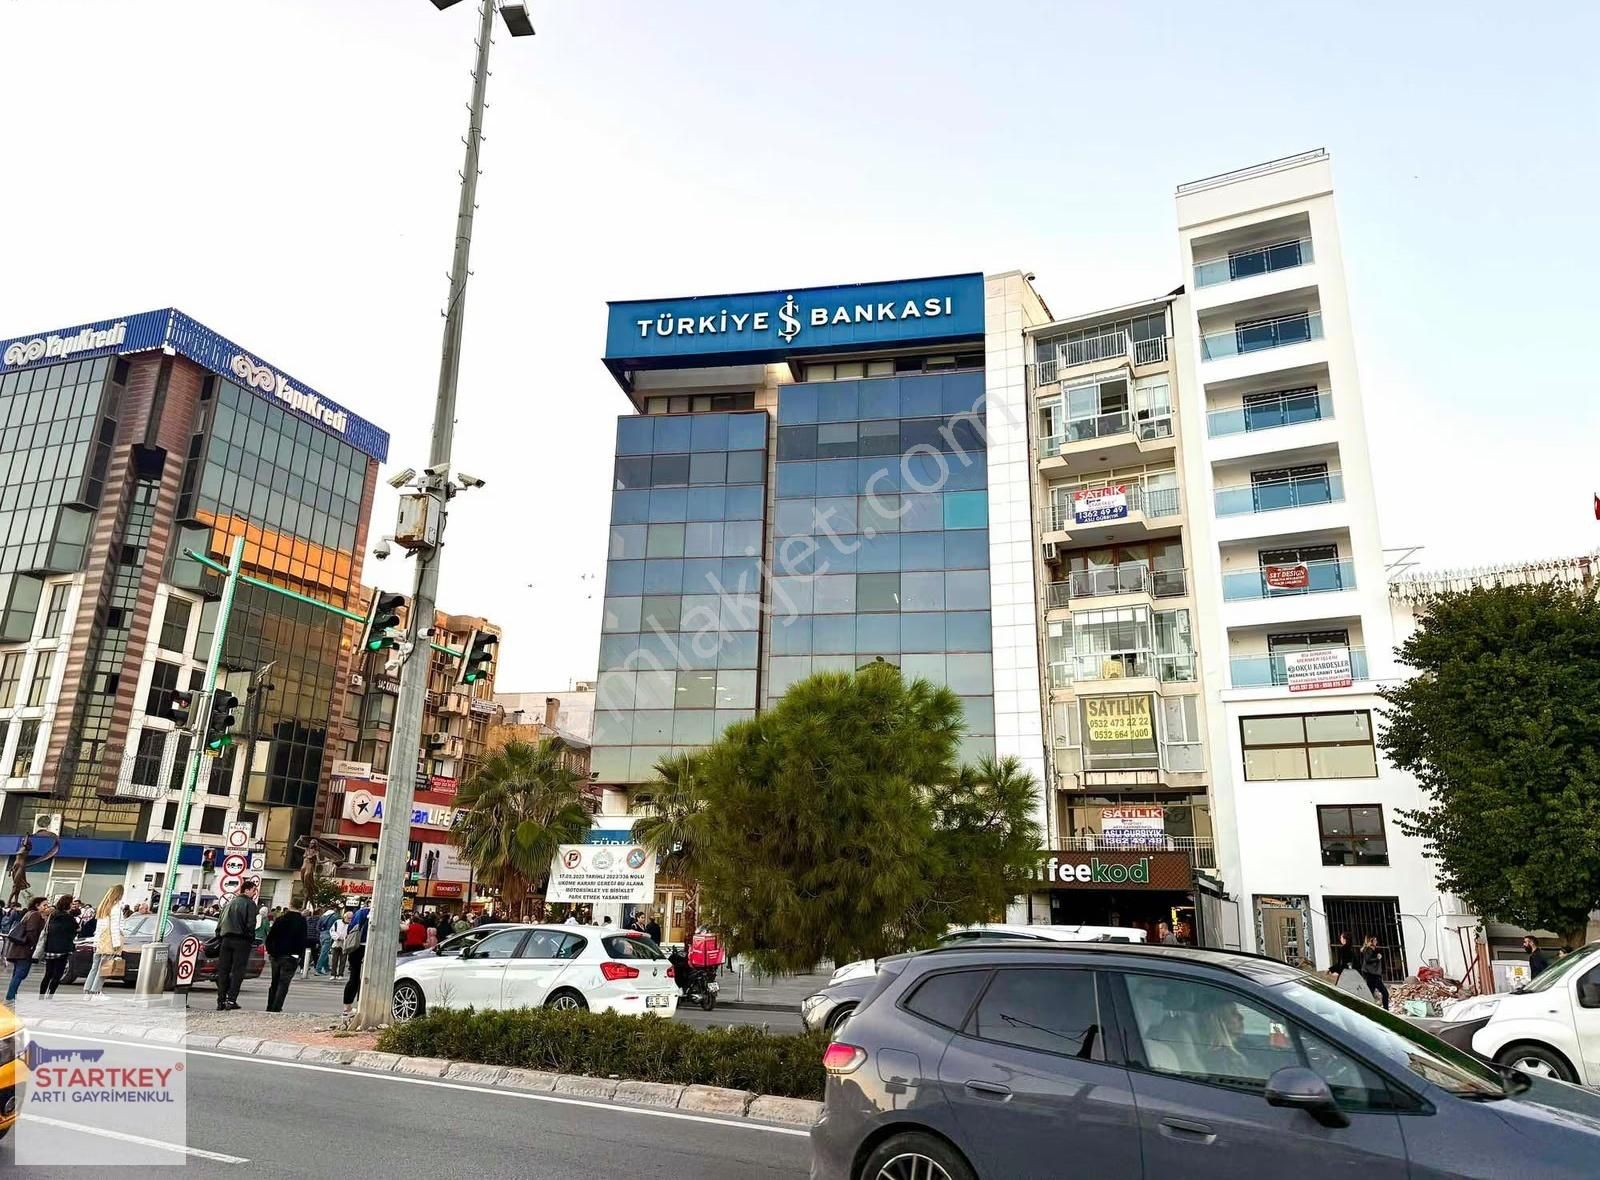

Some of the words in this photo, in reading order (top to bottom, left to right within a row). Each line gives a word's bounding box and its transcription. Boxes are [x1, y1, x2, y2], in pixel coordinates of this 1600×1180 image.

[637, 309, 769, 337] TÜRKİYE
[810, 296, 953, 327] BANKASI
[1079, 485, 1121, 499] SATILIK
[1088, 697, 1146, 716] SATILIK
[1090, 719, 1108, 728] 0532
[1110, 718, 1125, 727] 473
[1126, 717, 1136, 726] 22
[1138, 717, 1149, 726] 22
[1094, 730, 1113, 739] 0532
[1103, 809, 1161, 818] SATILIK
